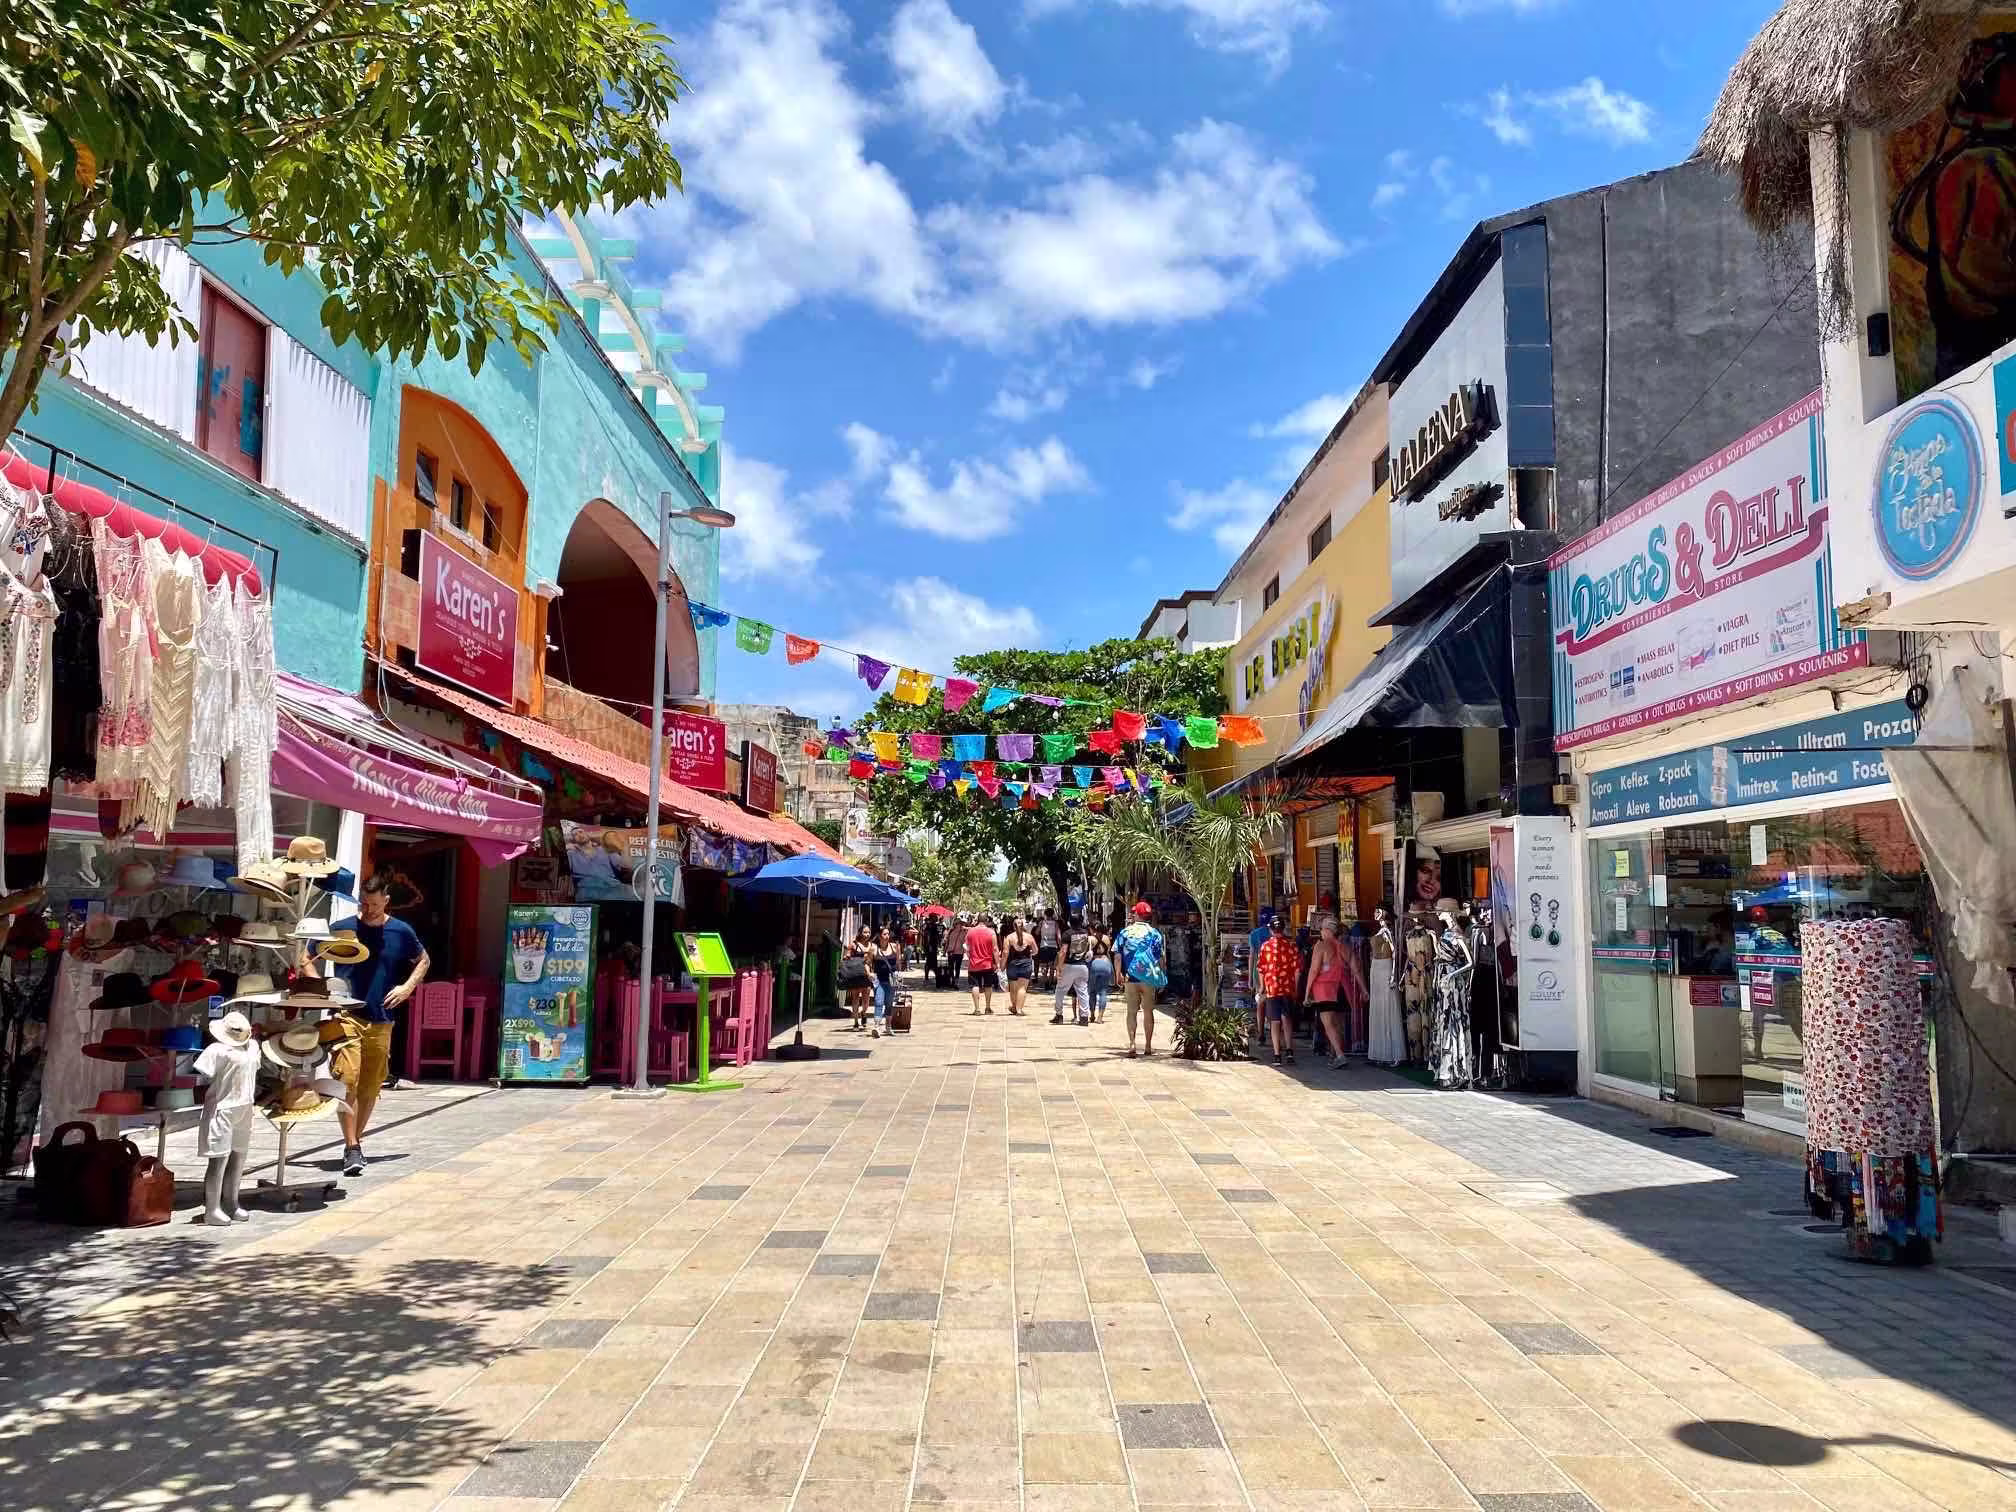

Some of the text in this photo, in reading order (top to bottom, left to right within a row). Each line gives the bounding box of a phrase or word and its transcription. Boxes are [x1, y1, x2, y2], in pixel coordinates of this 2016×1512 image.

[1389, 389, 1468, 502] MALENA
[1689, 461, 1714, 486] SNACKS
[1726, 444, 1745, 464] SOFT
[1745, 425, 1774, 453] DRINKS
[1571, 474, 1808, 642] DRUGS & DELI
[435, 556, 506, 641] Karen's
[1621, 571, 1743, 633] CONVENIENCE STORE
[1722, 612, 1750, 633] VIAGRA
[1641, 663, 1674, 682] ANABOLICS
[1723, 631, 1760, 656] DIET PILLS
[1561, 649, 1849, 744] PRESCRIPTION DRUGS GENERICS OTC DRUGS SNACKS SOFT DRINKS SOUVENIRS
[667, 726, 715, 755] aren's
[1591, 780, 1612, 799] Cipro
[1620, 771, 1649, 791] Keflex
[1658, 760, 1692, 785] Z-pack
[1797, 731, 1846, 754] Ultram
[1591, 802, 1619, 822] Amoxil
[1626, 800, 1650, 817] Aleve
[1736, 777, 1779, 798] Imitrex
[1791, 767, 1838, 790] Retin-a
